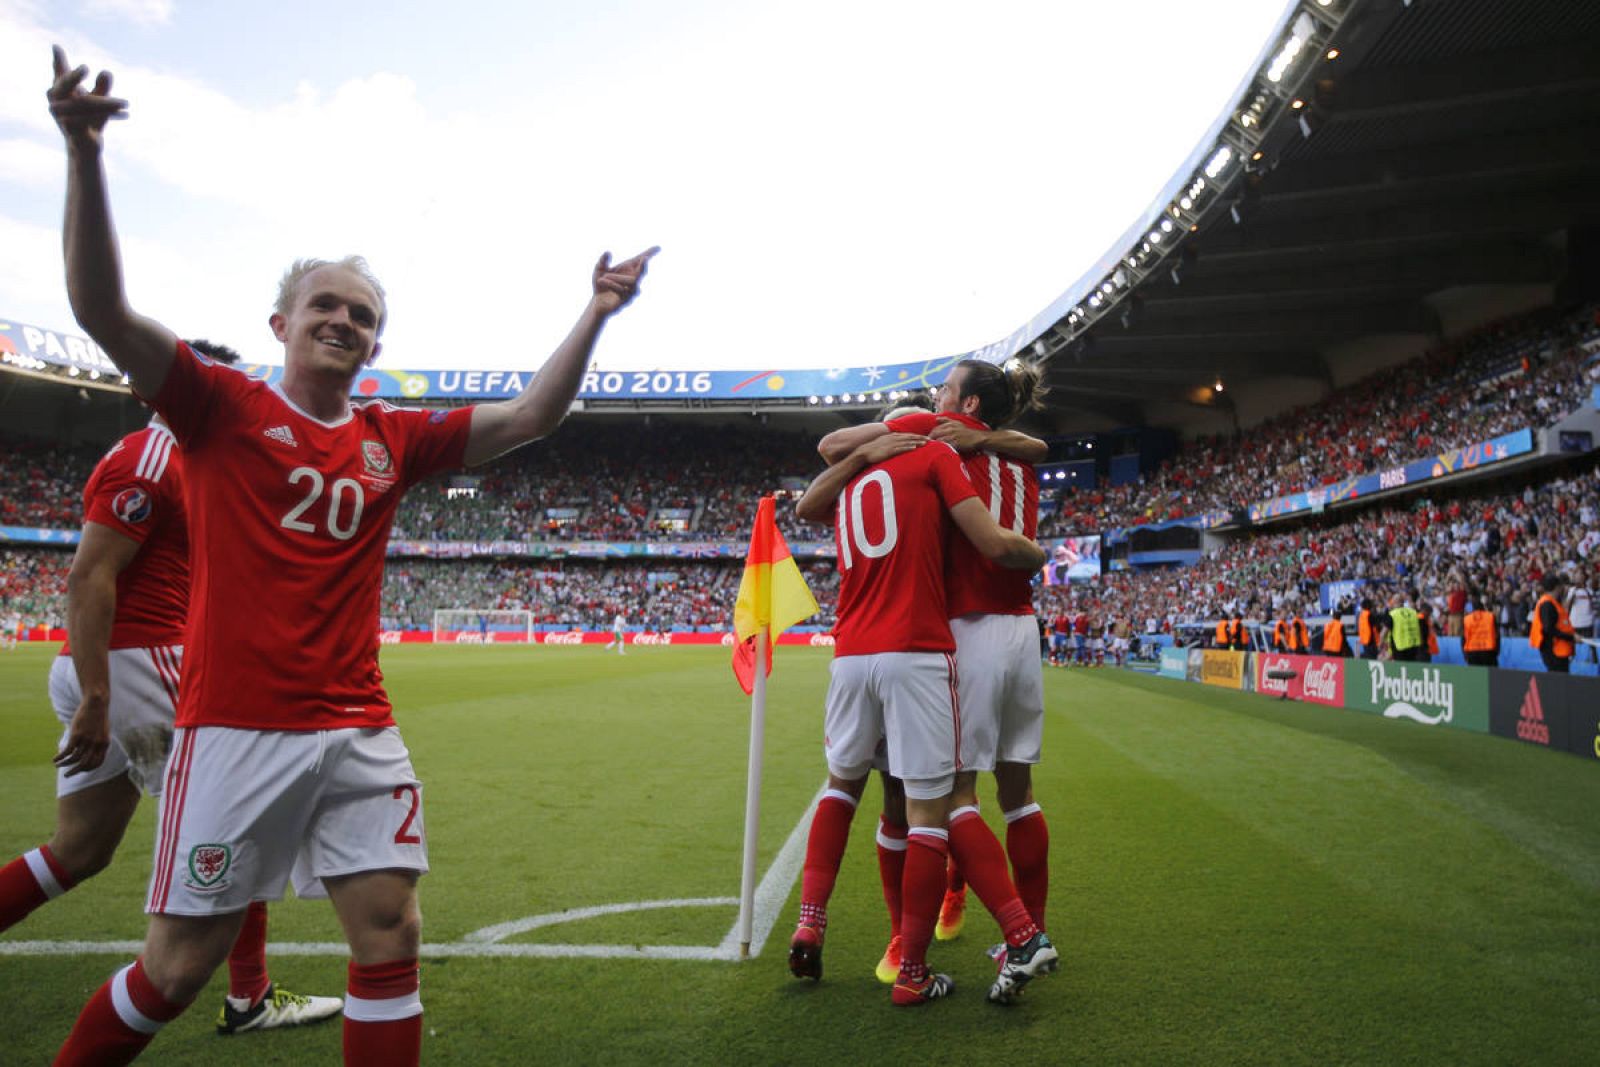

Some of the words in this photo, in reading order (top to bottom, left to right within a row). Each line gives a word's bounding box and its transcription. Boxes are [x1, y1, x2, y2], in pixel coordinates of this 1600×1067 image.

[438, 371, 523, 393] UEFA
[581, 372, 624, 393] RO
[631, 372, 712, 393] 2016
[1380, 467, 1405, 489] PARIS
[280, 466, 365, 541] 20
[837, 469, 899, 570] 10
[1368, 660, 1453, 723] Probably
[1516, 718, 1550, 745] adidas
